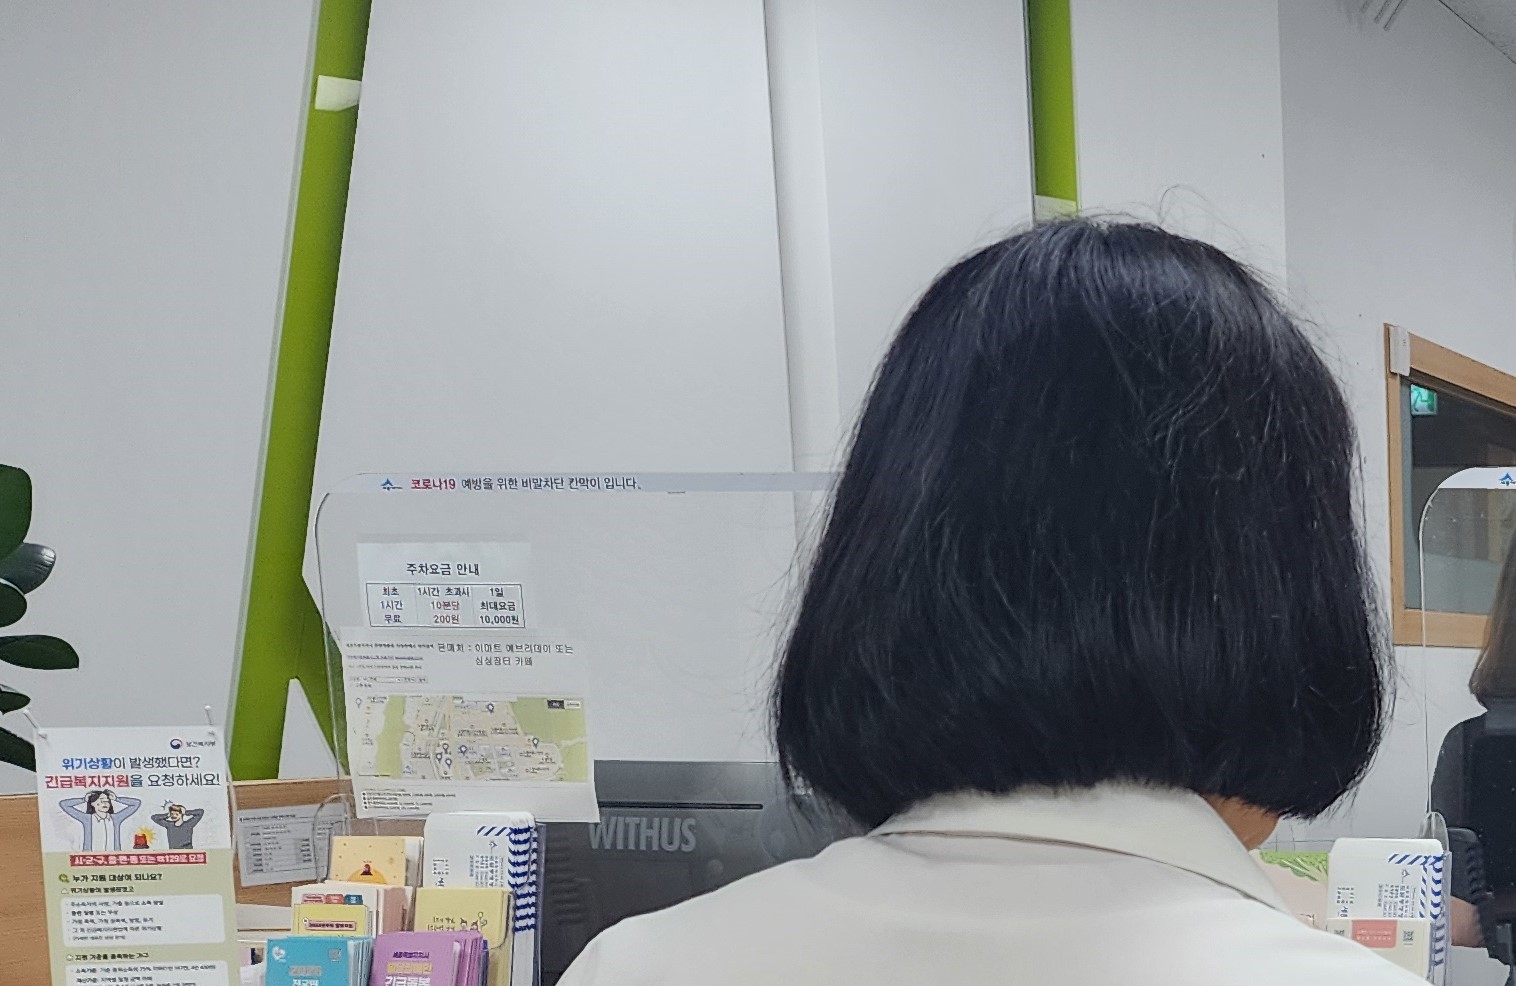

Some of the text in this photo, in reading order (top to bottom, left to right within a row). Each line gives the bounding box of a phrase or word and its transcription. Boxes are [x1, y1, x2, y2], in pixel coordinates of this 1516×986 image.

[411, 477, 456, 490] 코로나19
[497, 477, 518, 490] 위한
[521, 477, 565, 490] 비말차단
[604, 477, 642, 490] 입니다.
[406, 563, 480, 577] 주차요금 안내
[417, 586, 440, 597] 1시간
[489, 587, 504, 598] 1일
[380, 601, 404, 611] 1시간
[480, 602, 516, 612] 최대요금
[433, 614, 460, 625] 200원
[480, 615, 519, 626] 10,000원
[475, 643, 503, 653] 이마트
[506, 643, 551, 653] 에브리데이
[556, 644, 574, 654] 또는
[62, 755, 201, 771] 위기상황이 발생했다면?
[45, 772, 221, 789] 긴급복지지원을 요청하세요!
[588, 816, 697, 852] WITHUS
